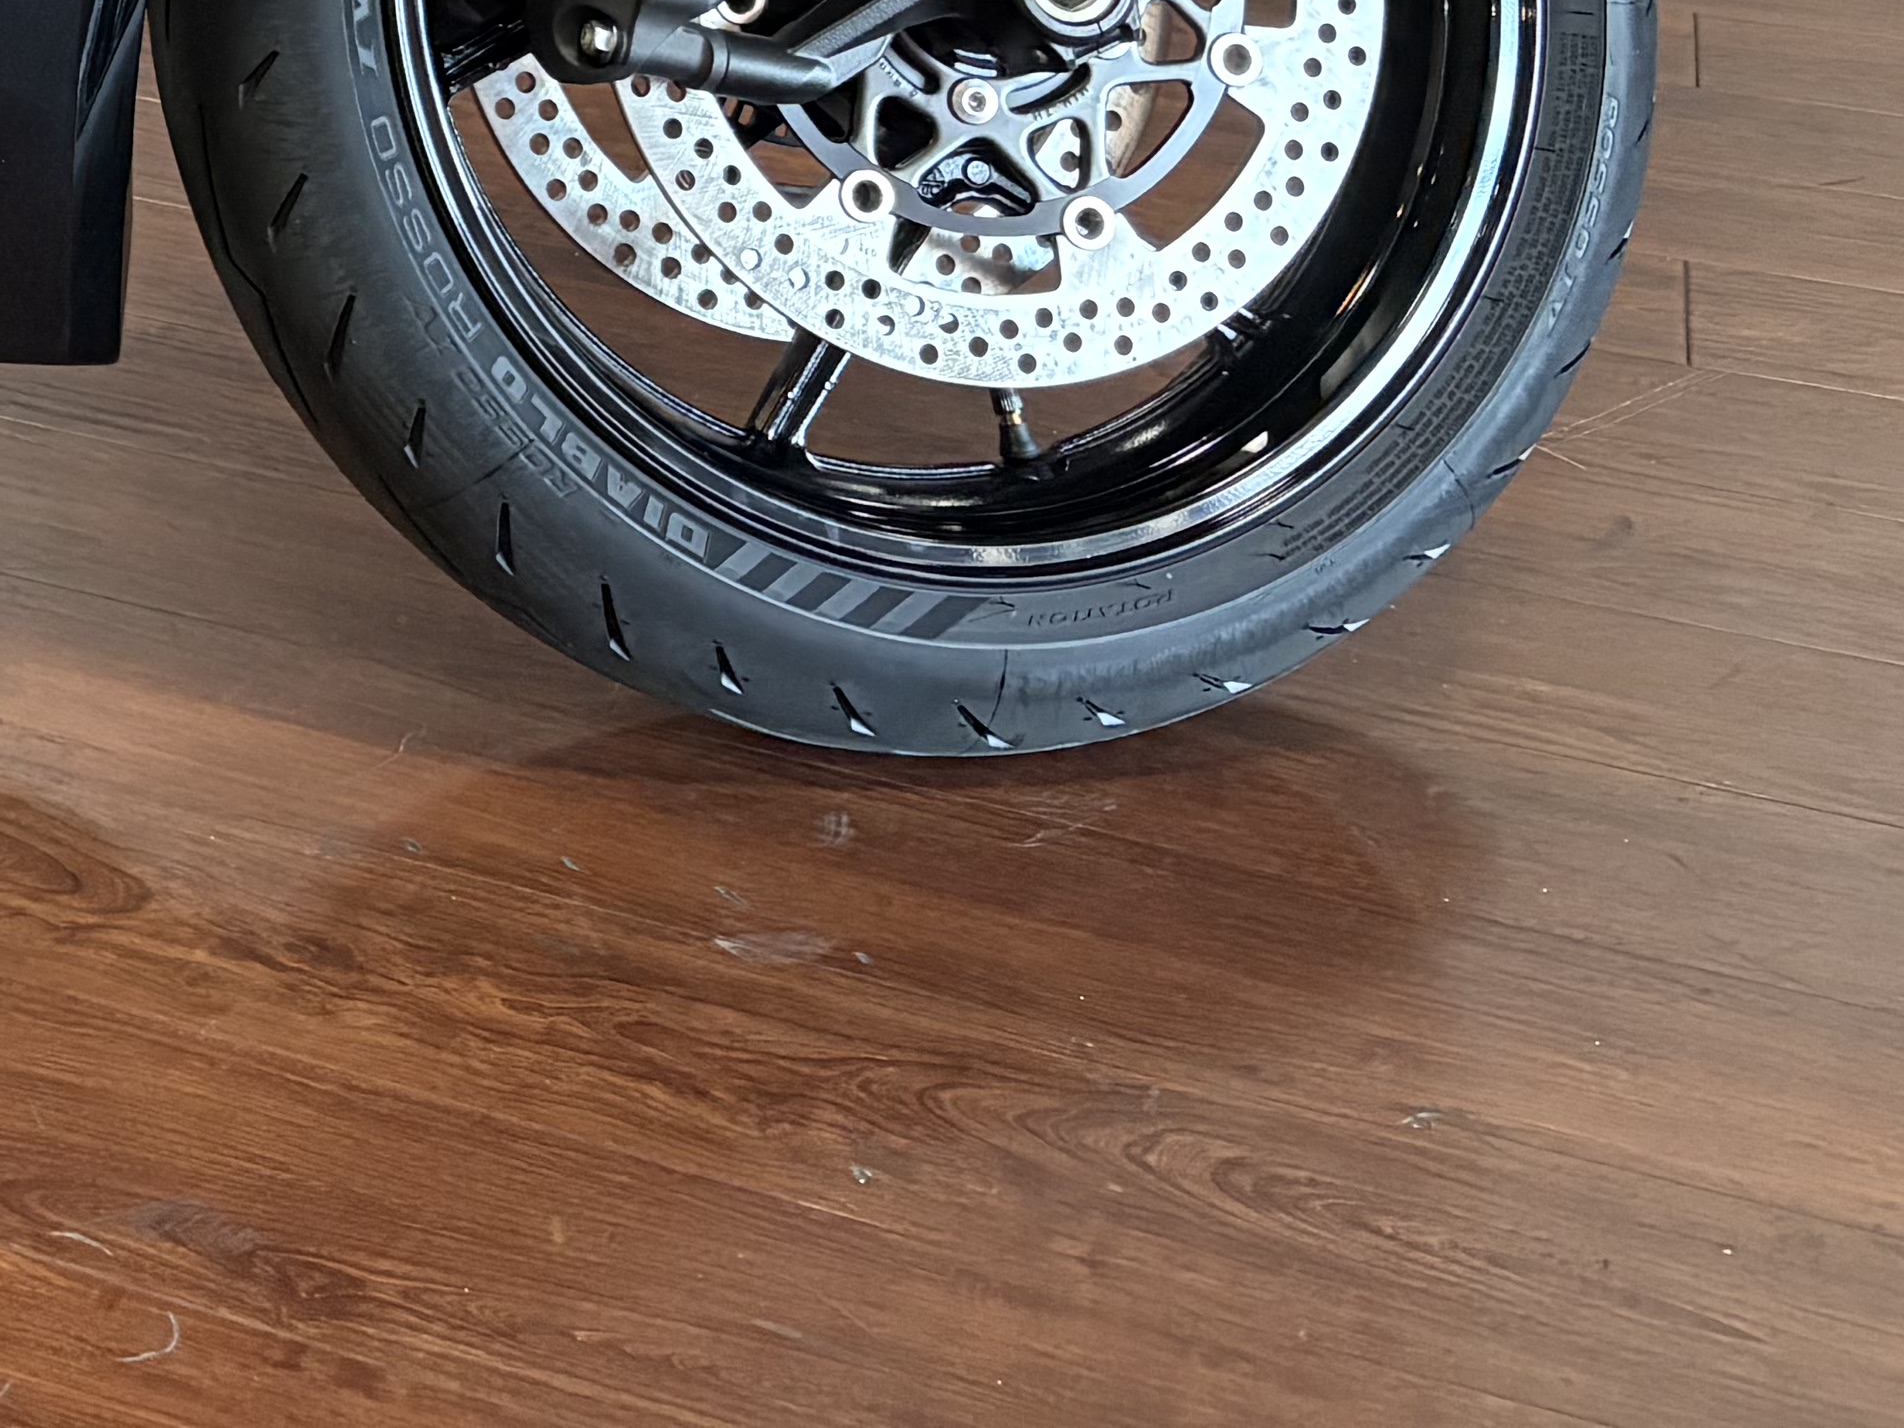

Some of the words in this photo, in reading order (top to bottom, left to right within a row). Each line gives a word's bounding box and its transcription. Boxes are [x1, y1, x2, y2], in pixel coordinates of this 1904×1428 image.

[370, 114, 484, 344] ROSSO
[1573, 95, 1619, 260] ROSSO
[492, 355, 711, 564] DIABLO
[1026, 587, 1176, 629] ROTATION
